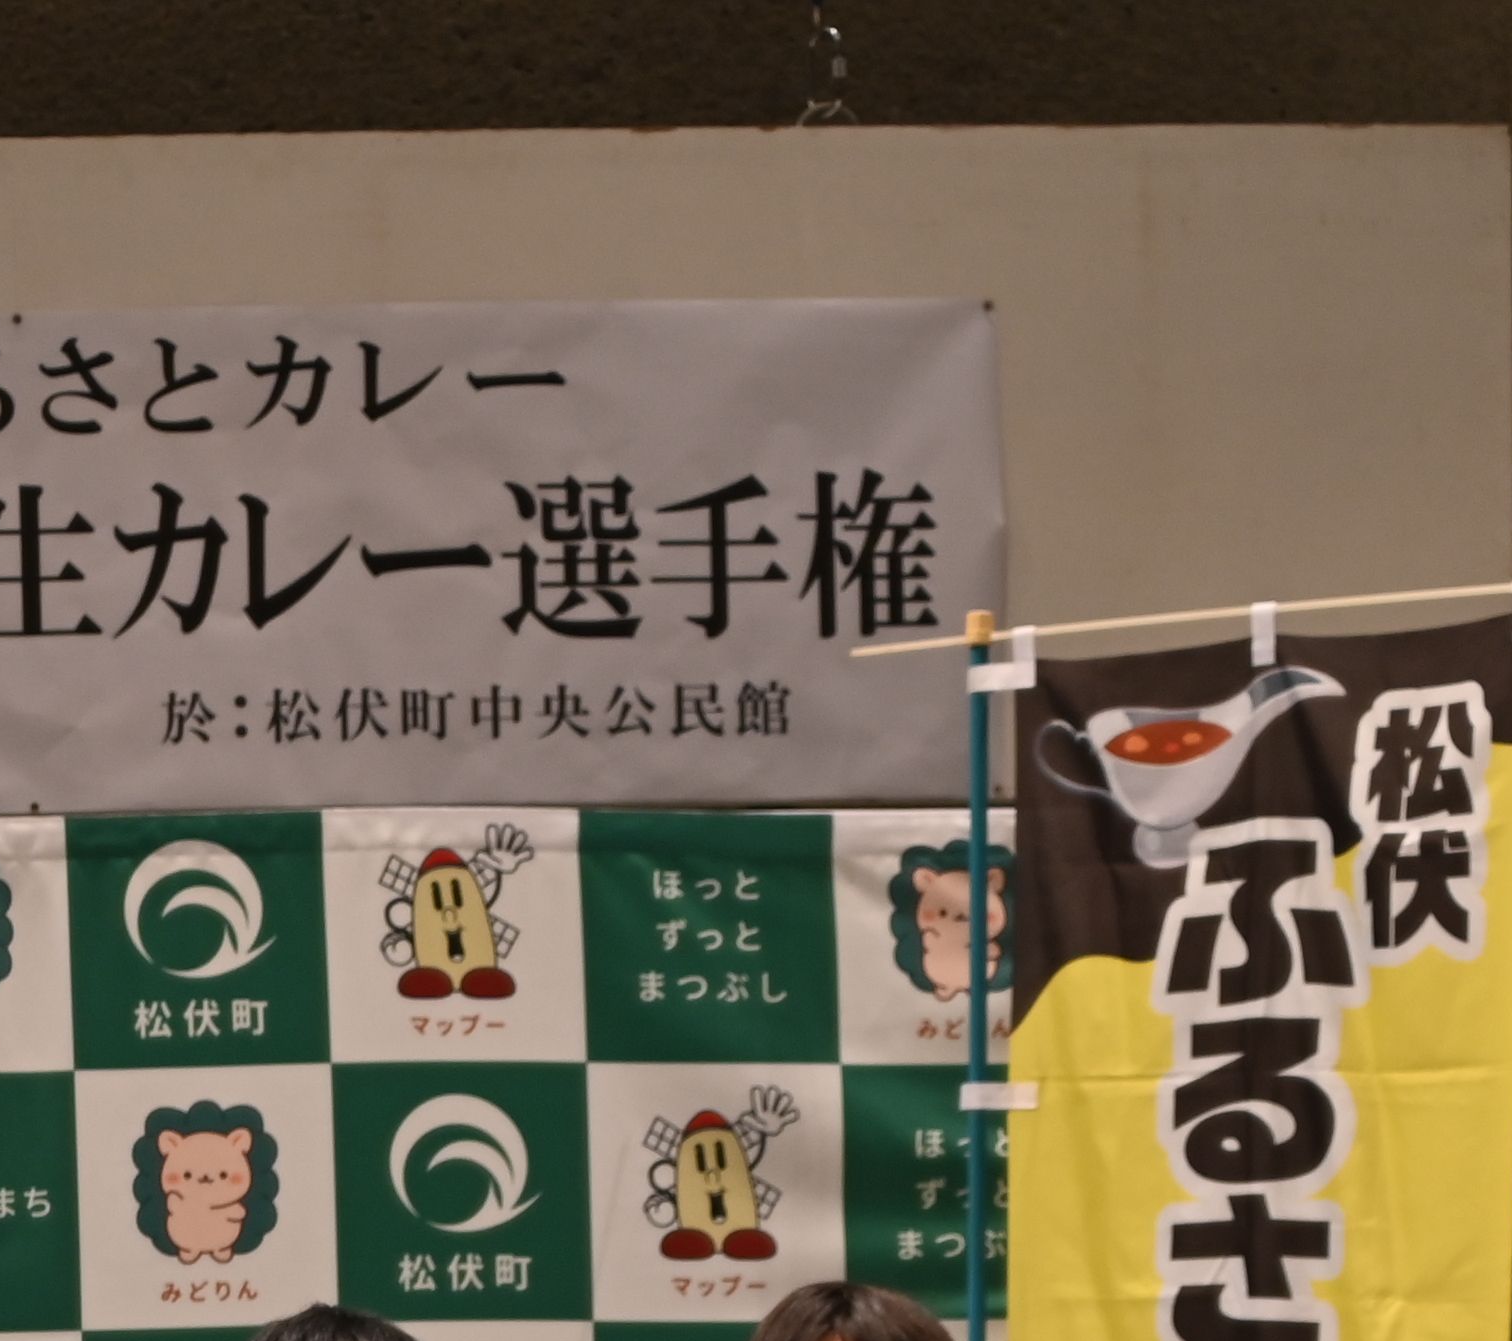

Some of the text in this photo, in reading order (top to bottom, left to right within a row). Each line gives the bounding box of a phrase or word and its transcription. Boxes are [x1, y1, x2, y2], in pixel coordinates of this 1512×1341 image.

[1369, 701, 1474, 949] 松伏
[652, 869, 759, 901] ほっと
[656, 918, 761, 952] ずっと
[639, 970, 787, 1004] まつぶし
[134, 998, 268, 1039] 松伏町
[411, 1014, 506, 1037] マップー
[915, 1016, 1011, 1041] みどん
[398, 1253, 532, 1292] 松伏町
[671, 1275, 767, 1298] マップー
[160, 1280, 258, 1303] みどりん
